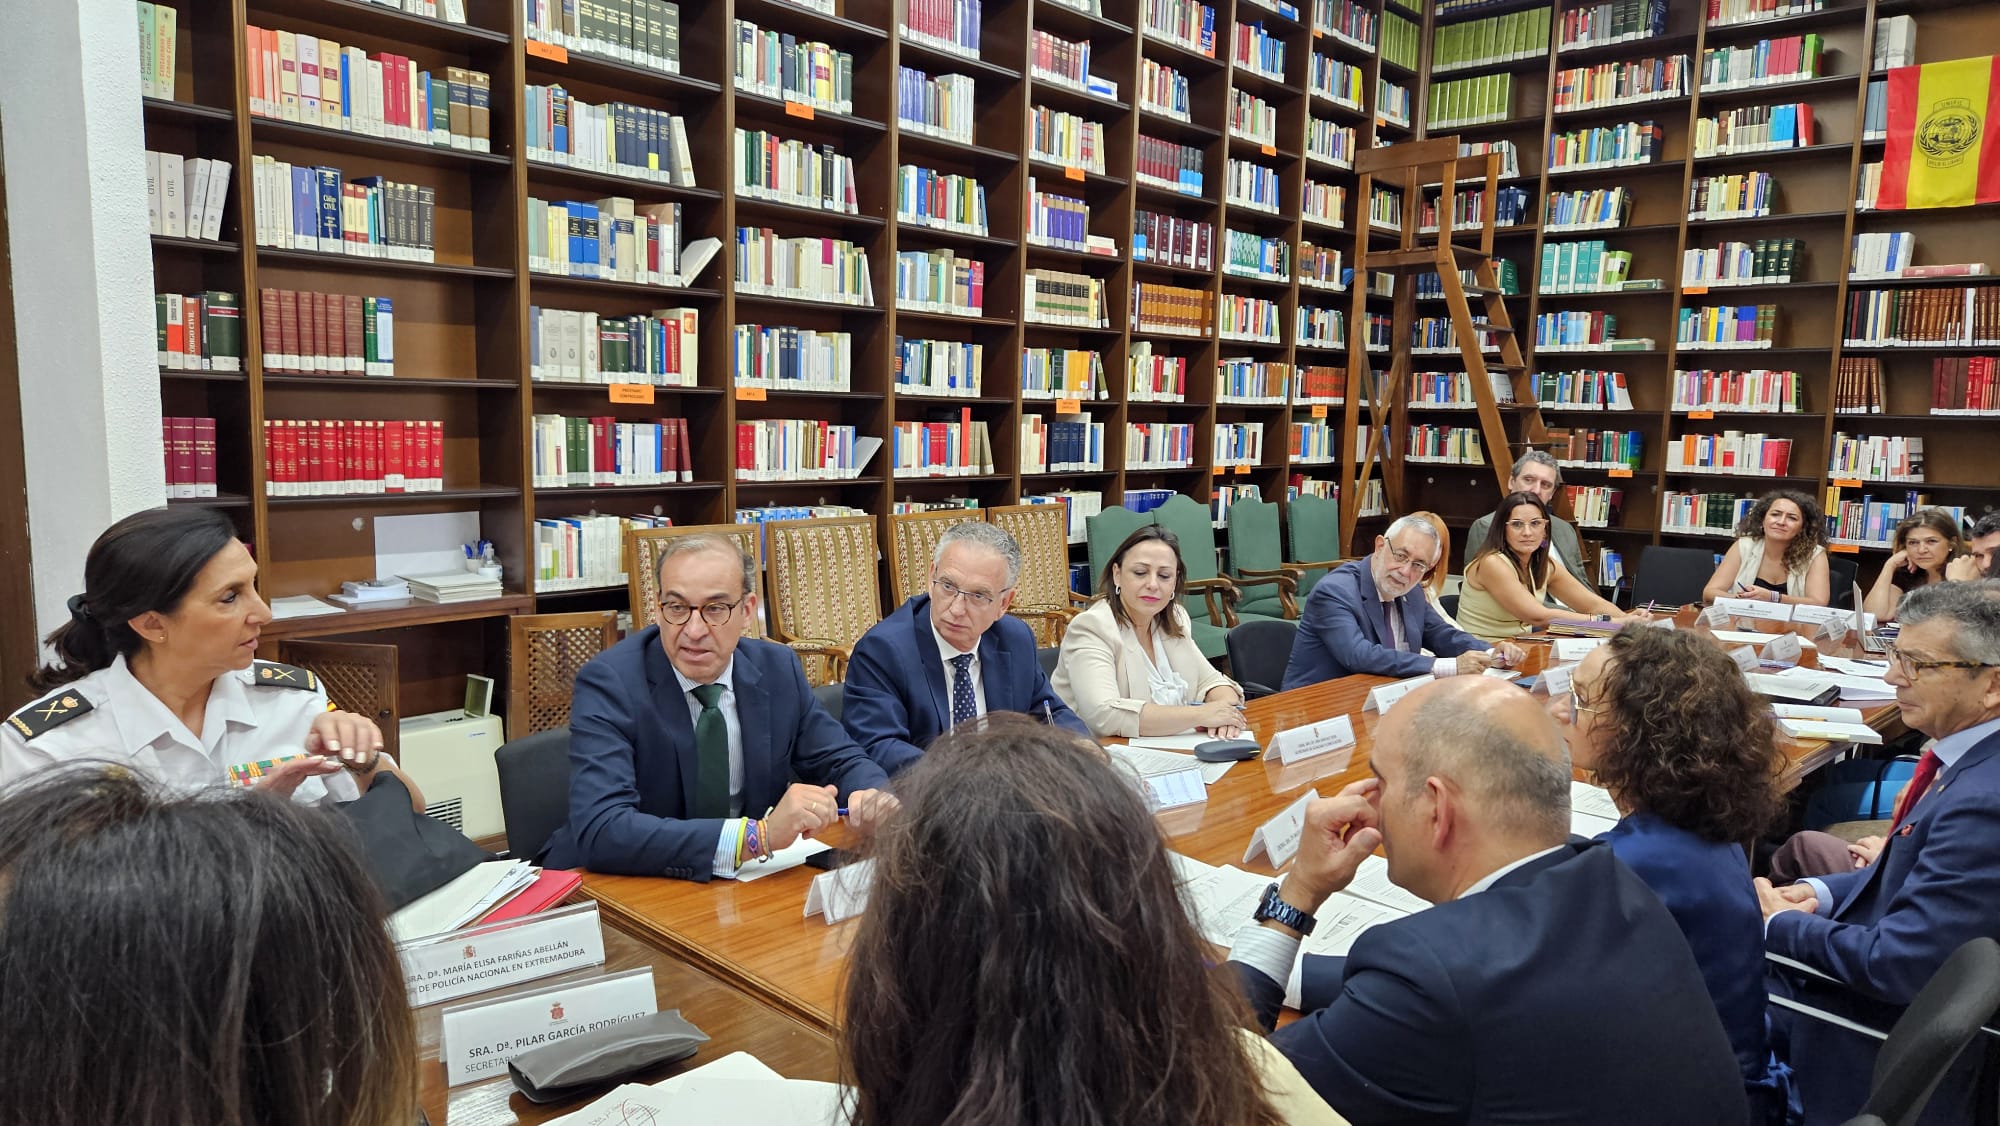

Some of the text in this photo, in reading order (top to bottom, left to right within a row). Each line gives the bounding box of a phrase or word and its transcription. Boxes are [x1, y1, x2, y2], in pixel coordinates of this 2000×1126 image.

[147, 177, 155, 195] CIVIL
[167, 180, 175, 197] CIVIL
[419, 948, 585, 993] DE POLICÍA NACIONAL EN EXTREMADURA
[443, 961, 472, 976] MARÍA
[474, 957, 496, 969] ELISA
[498, 949, 532, 963] FARIÑAS
[534, 940, 568, 954] ABELLÁN
[469, 1046, 493, 1058] SRA.
[516, 1034, 545, 1048] PILAR
[548, 1024, 586, 1041] GARCÍA
[465, 1054, 518, 1074] SECRETAR
